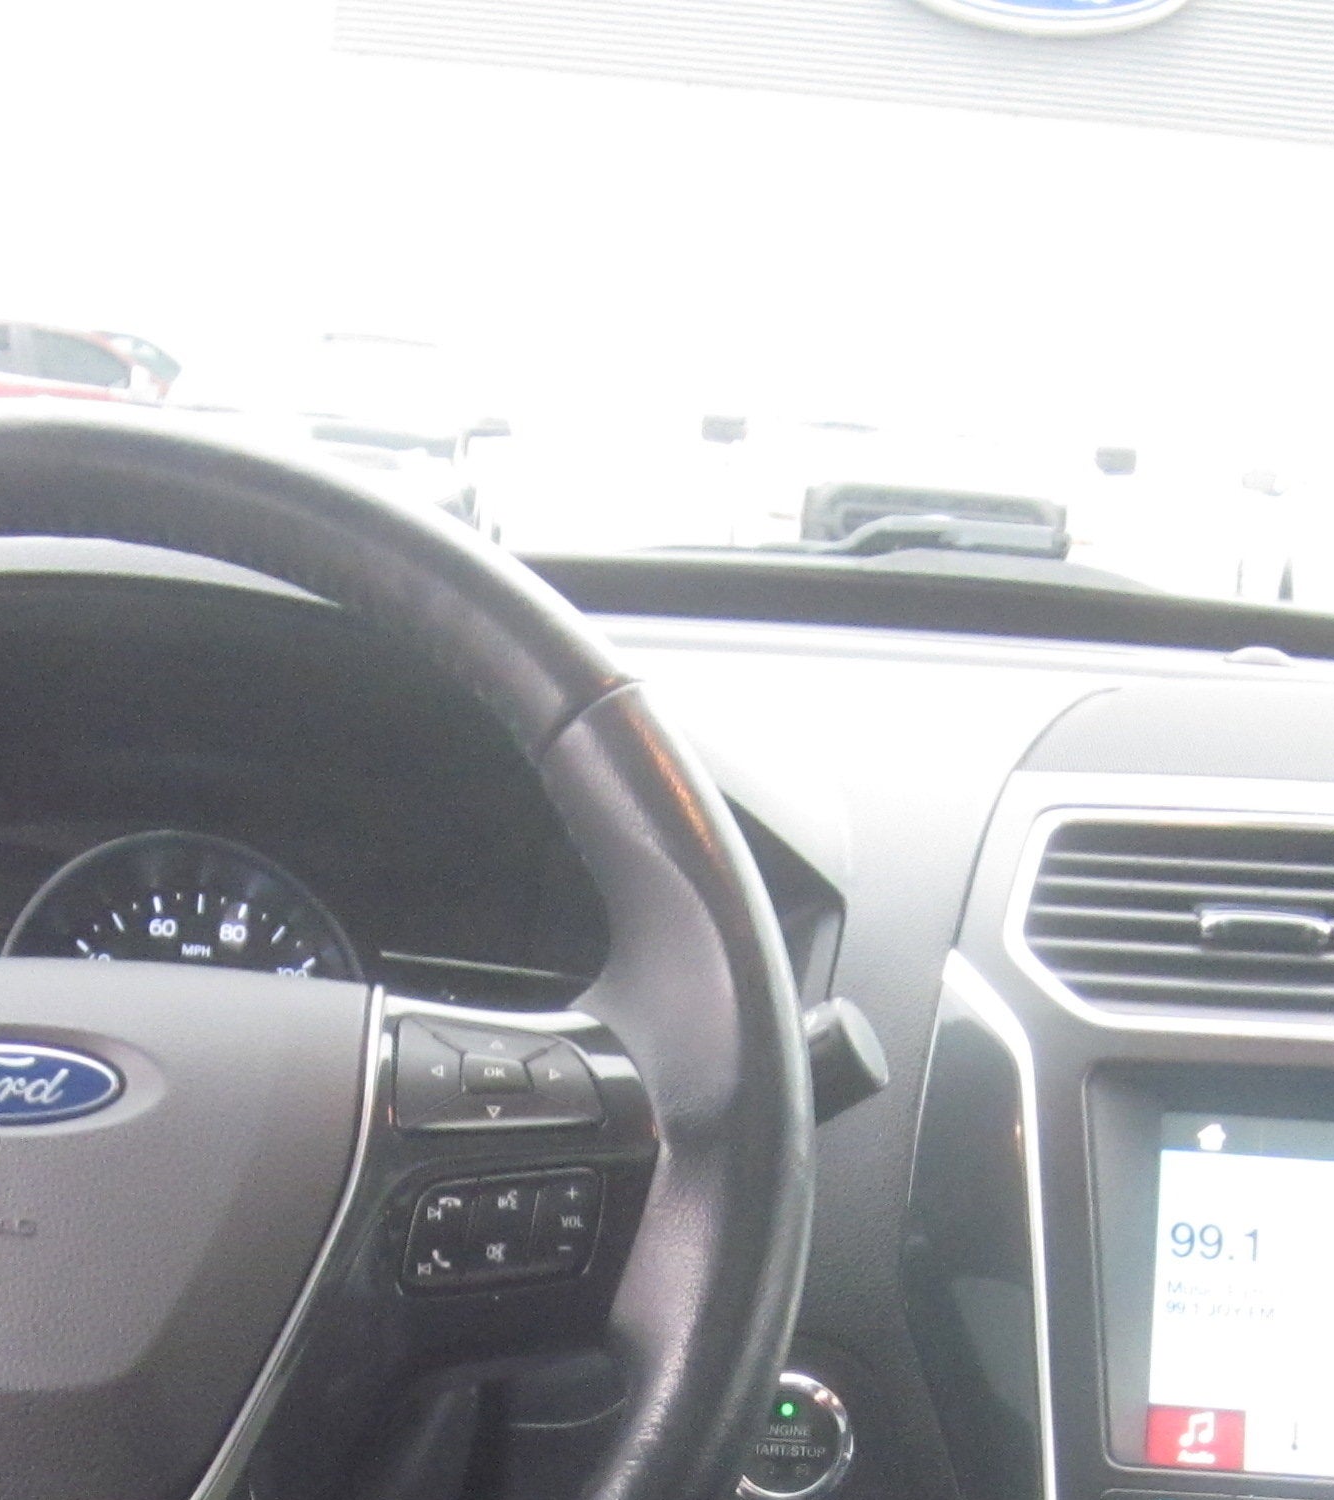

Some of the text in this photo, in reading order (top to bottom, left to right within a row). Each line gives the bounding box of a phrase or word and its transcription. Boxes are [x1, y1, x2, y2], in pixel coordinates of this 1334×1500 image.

[148, 918, 177, 938] 60
[219, 922, 248, 942] 80
[180, 942, 212, 958] MPH
[483, 1066, 506, 1079] OK
[560, 1214, 584, 1229] VOL
[1170, 1221, 1260, 1262] 99.1
[767, 1423, 810, 1437] NGINE
